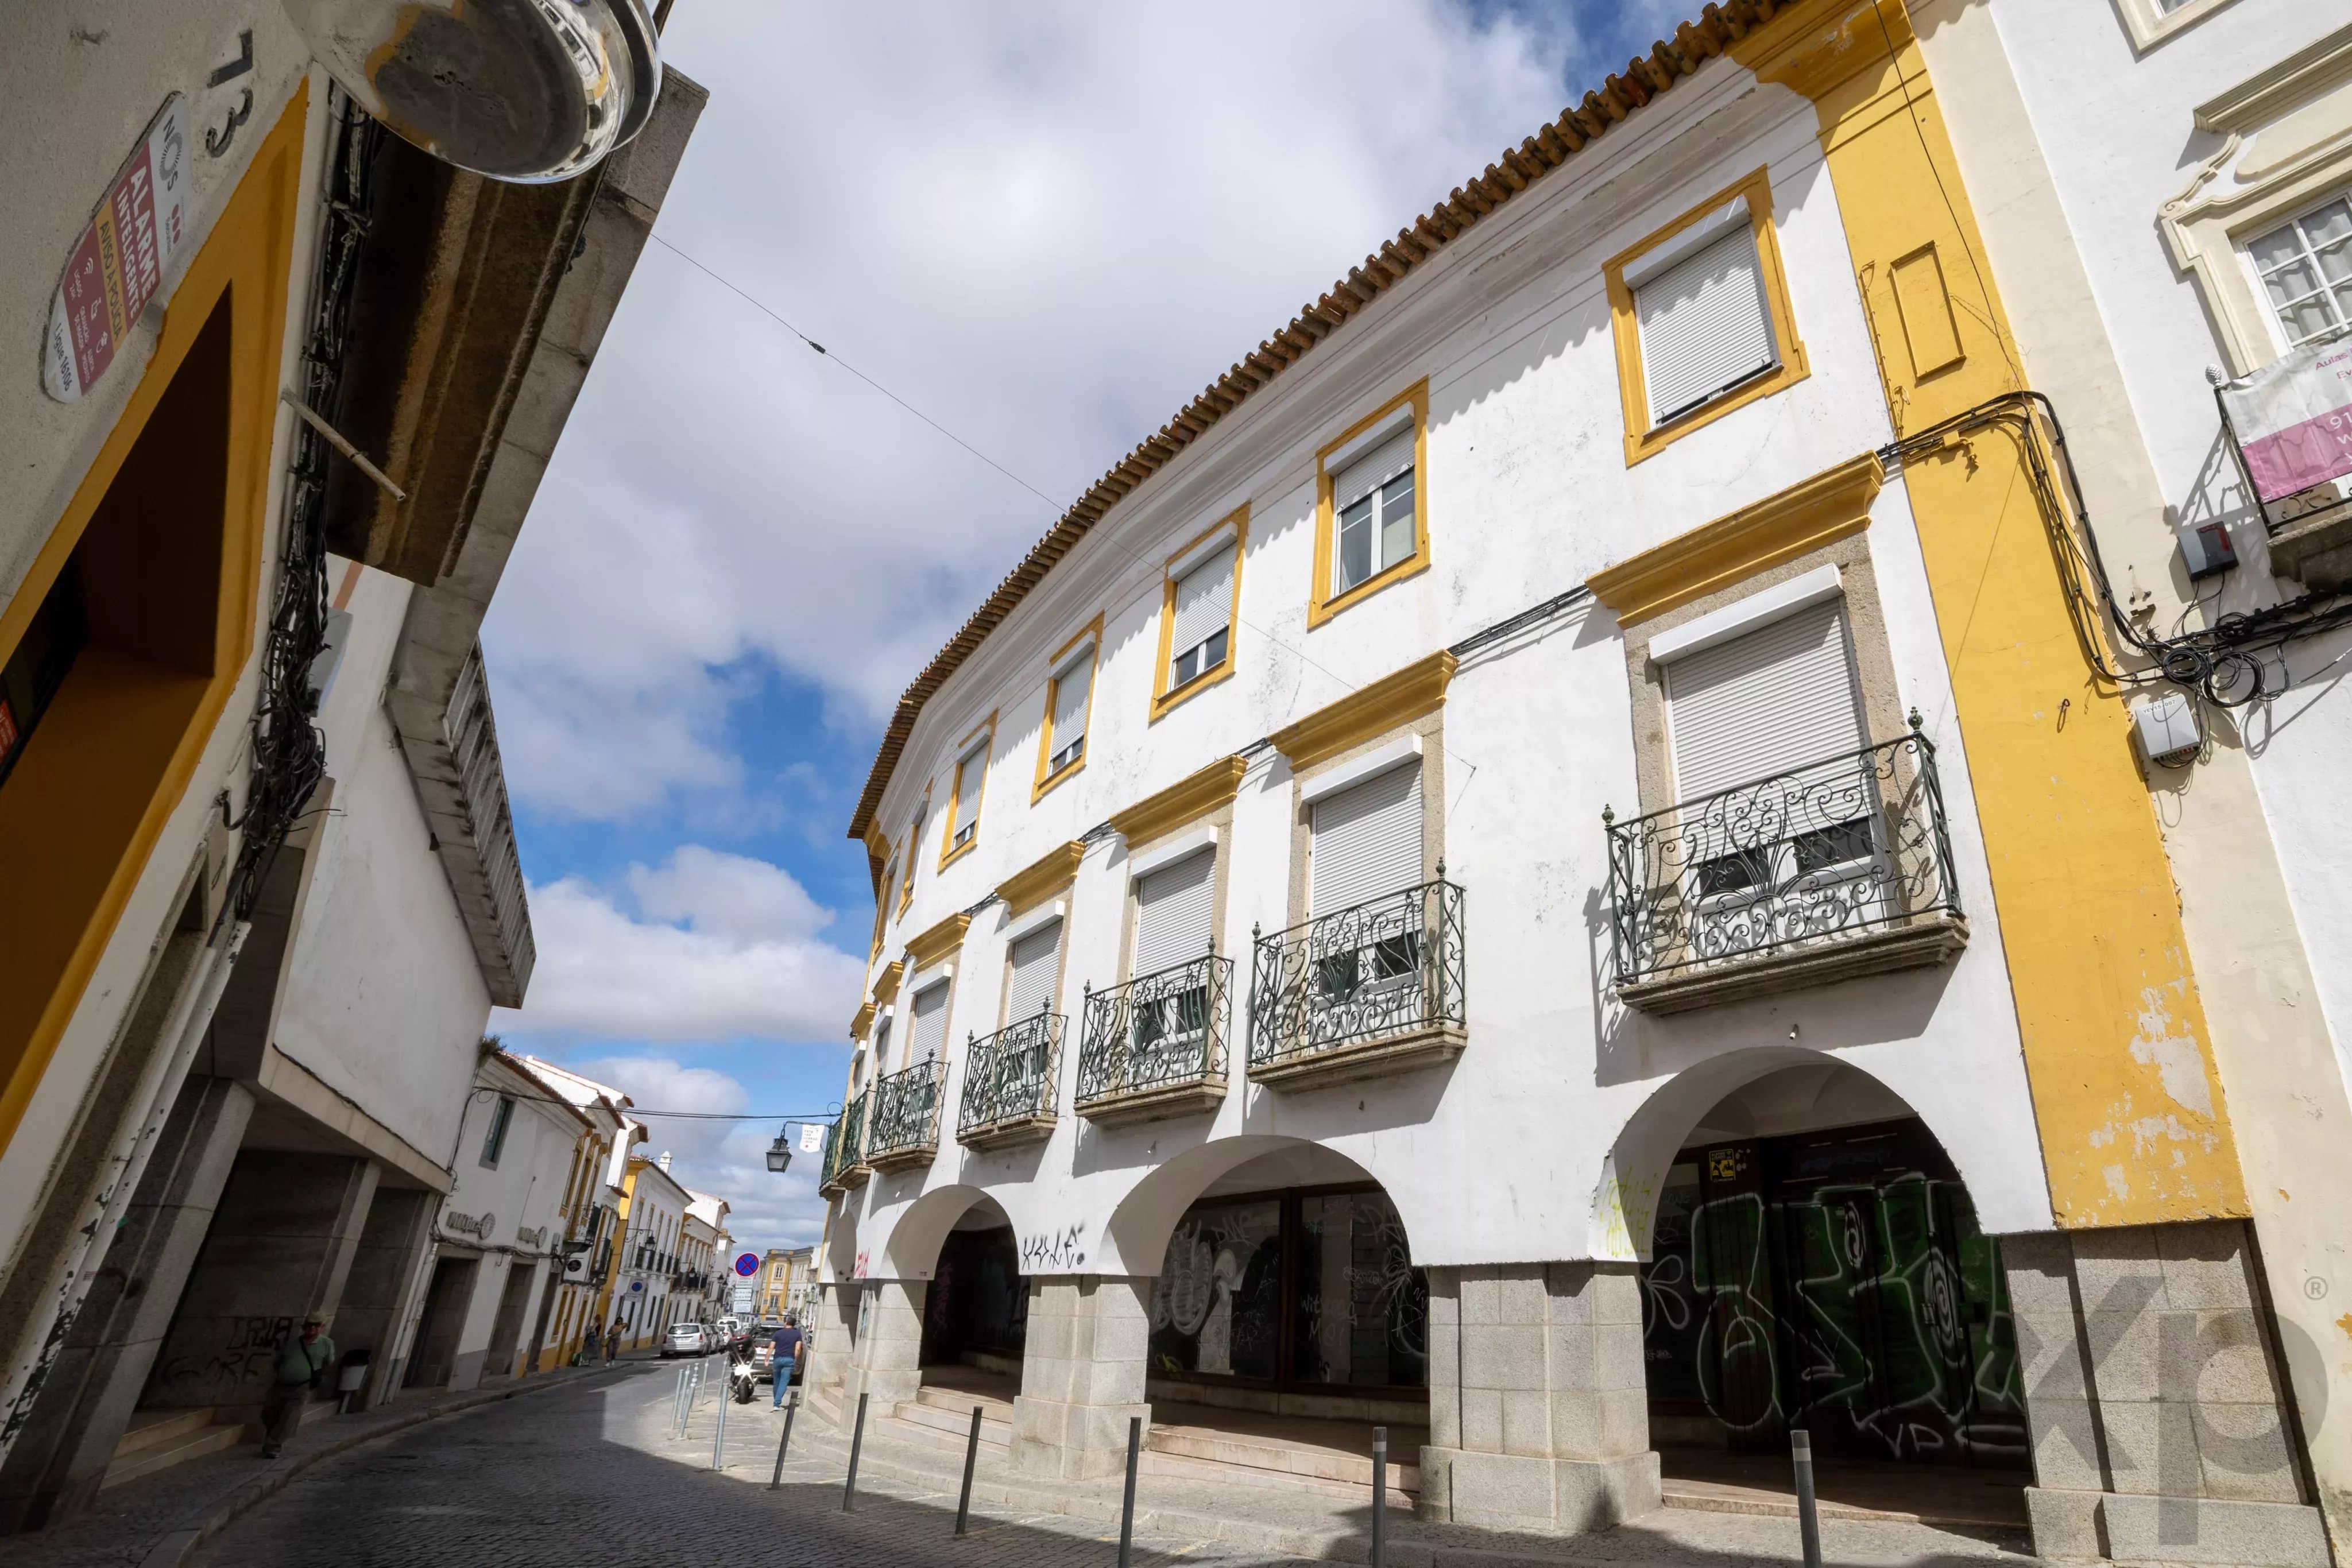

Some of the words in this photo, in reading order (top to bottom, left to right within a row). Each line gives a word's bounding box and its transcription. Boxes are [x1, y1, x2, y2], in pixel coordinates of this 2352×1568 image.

[158, 114, 183, 192] NOS
[117, 186, 139, 320] INTELIGENTE
[130, 164, 157, 301] ALARME
[74, 268, 83, 299] LIGADO
[99, 219, 113, 270] AVISO
[108, 280, 123, 343] POLÍCIA
[54, 323, 65, 361] Ligue
[60, 355, 72, 392] 16106
[2315, 352, 2349, 371] Aulas
